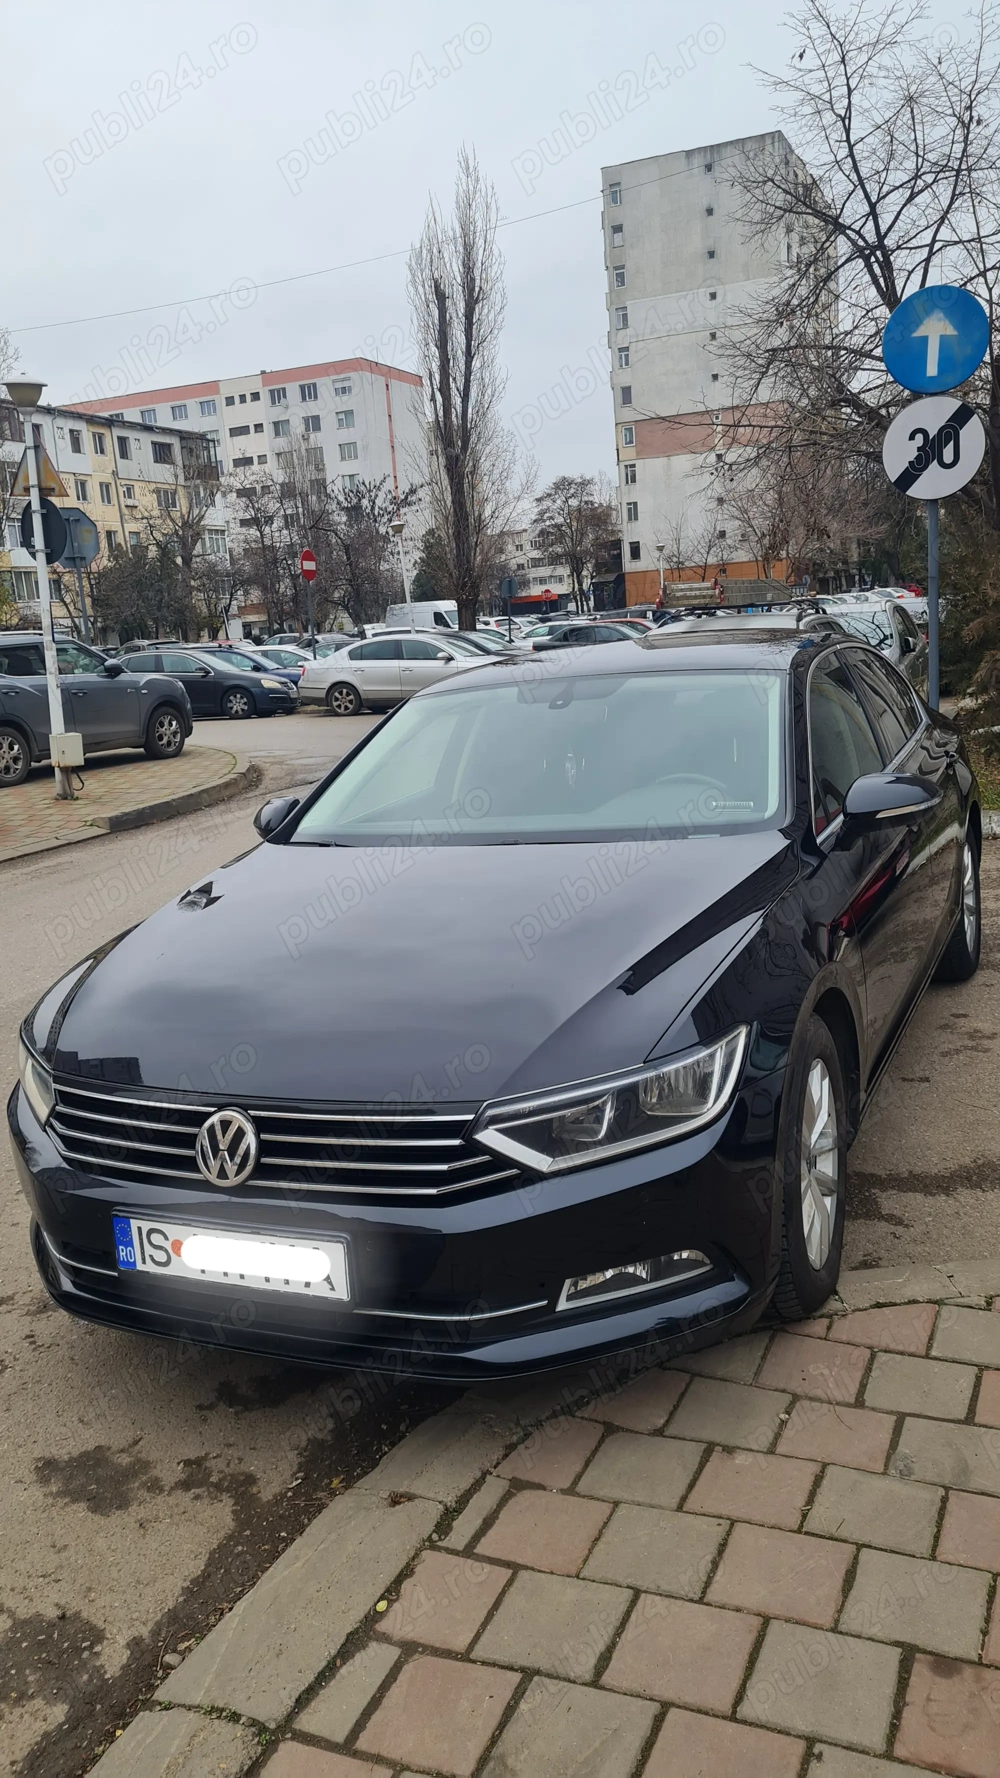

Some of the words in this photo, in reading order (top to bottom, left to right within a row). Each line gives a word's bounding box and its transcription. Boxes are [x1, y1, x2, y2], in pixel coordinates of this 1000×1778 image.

[908, 422, 961, 474] 30
[198, 1112, 253, 1185] VW
[119, 1246, 134, 1262] RO
[137, 1226, 171, 1267] IS
